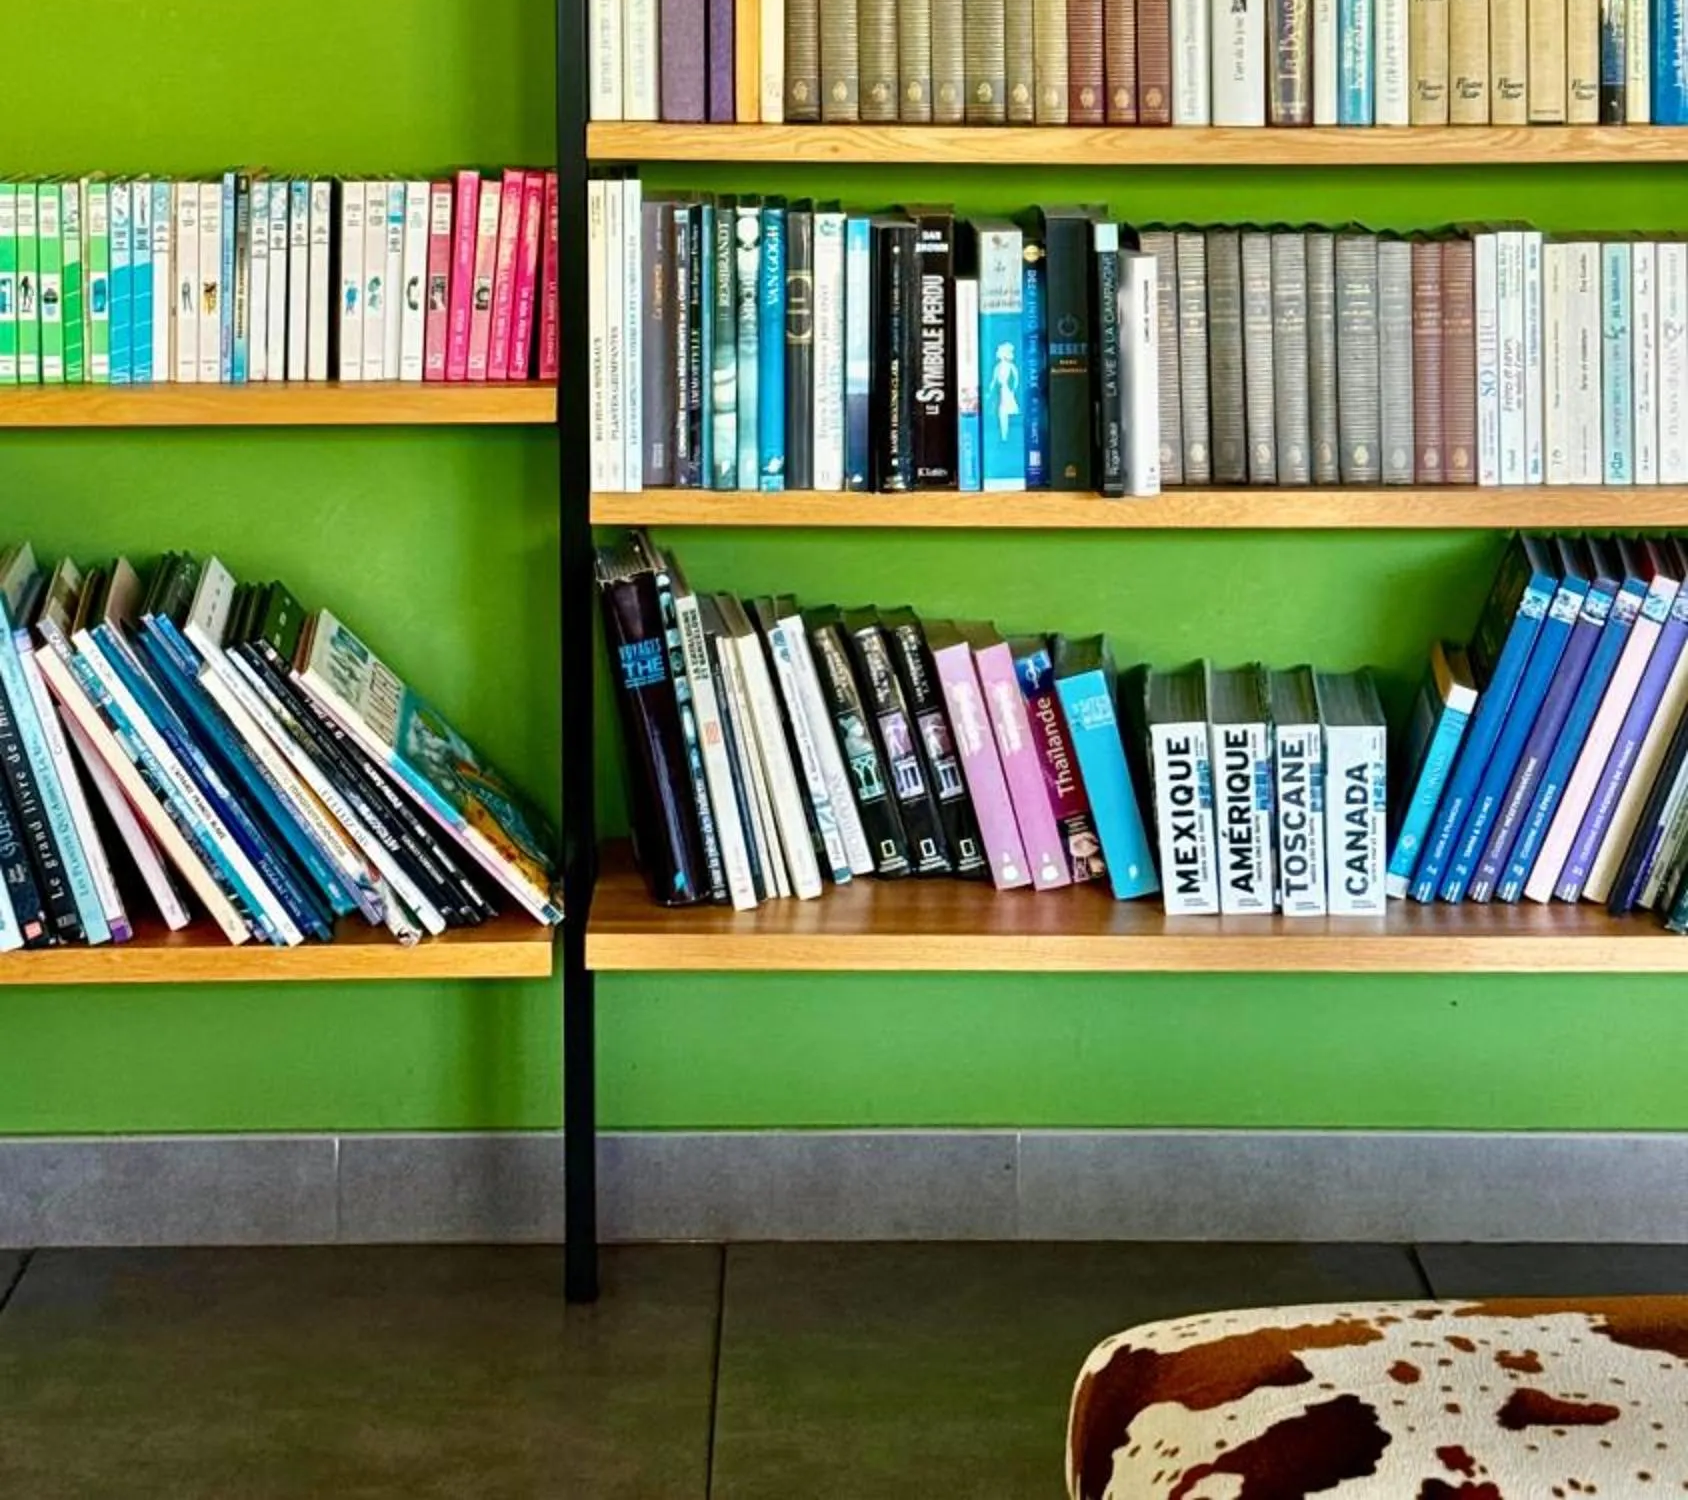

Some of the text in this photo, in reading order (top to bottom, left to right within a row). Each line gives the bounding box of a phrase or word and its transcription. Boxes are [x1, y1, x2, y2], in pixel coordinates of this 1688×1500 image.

[718, 220, 731, 307] REMBRANDT
[766, 224, 779, 306] VAN GOGH
[1101, 253, 1115, 324] CAMPAGNE
[915, 275, 945, 416] LE SYMBOLE PERDU
[1103, 326, 1115, 343] LA
[1104, 359, 1116, 378] VIE
[1105, 380, 1117, 397] LA
[1479, 371, 1497, 398] SO
[621, 655, 665, 680] THE
[1038, 696, 1076, 798] Thaïlande
[4, 743, 65, 900] Le grand livre de
[1166, 736, 1201, 894] MEXIQUE
[1221, 729, 1255, 895] AMÉRIQUE
[1281, 739, 1308, 898] TOSCANE
[1344, 762, 1369, 897] CANADA
[1518, 827, 1538, 860] CUISINE
